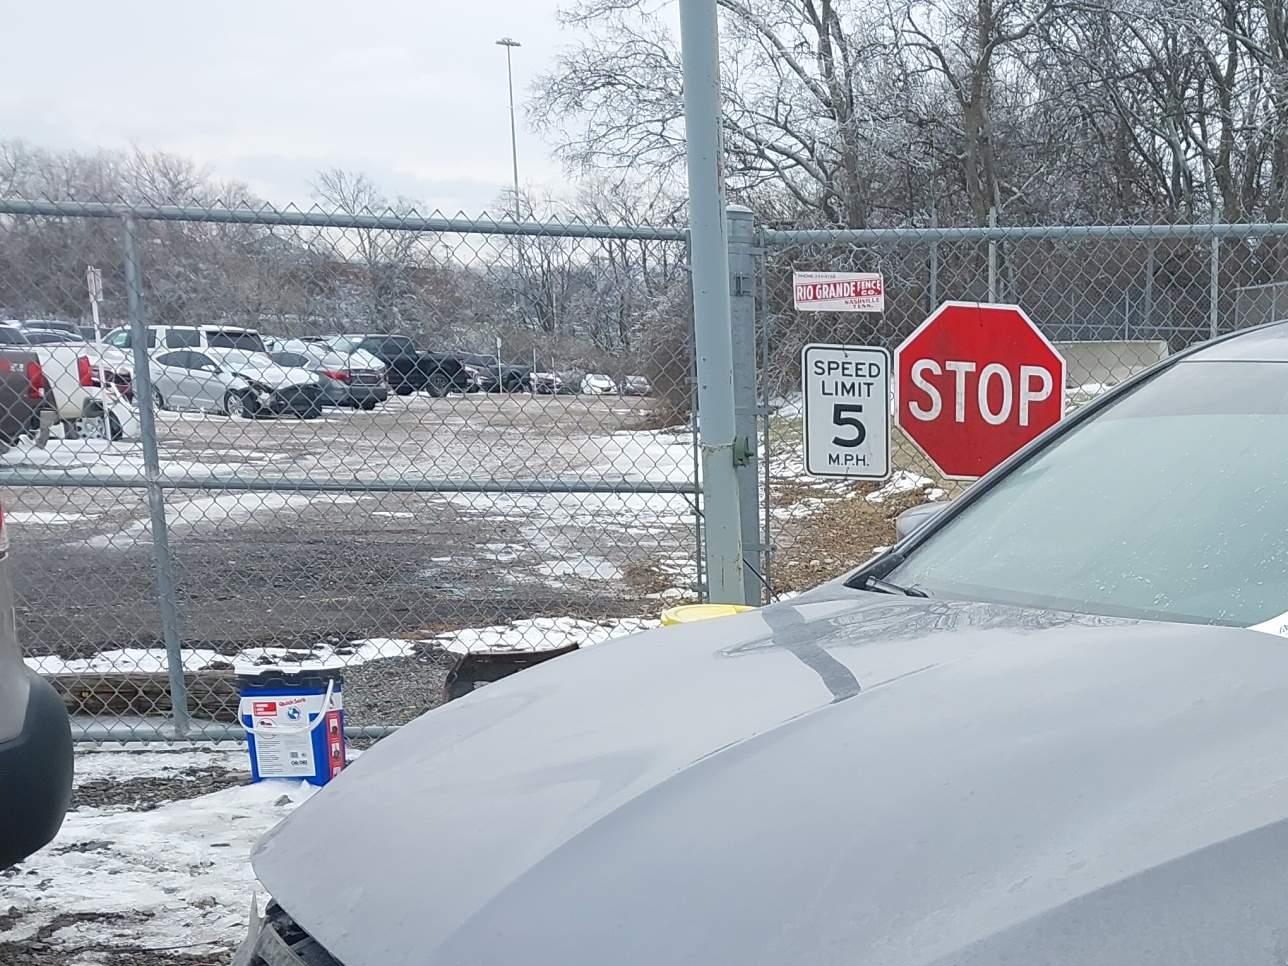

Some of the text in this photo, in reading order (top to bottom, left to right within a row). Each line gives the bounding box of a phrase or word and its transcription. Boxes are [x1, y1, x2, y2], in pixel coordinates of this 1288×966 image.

[797, 281, 856, 301] RIO GRANDE
[857, 280, 881, 291] FENCE
[814, 360, 881, 378] SPEED
[821, 380, 875, 398] LIMIT
[908, 358, 1053, 427] STOP
[832, 403, 867, 448] 5
[828, 453, 869, 467] M.P.H.
